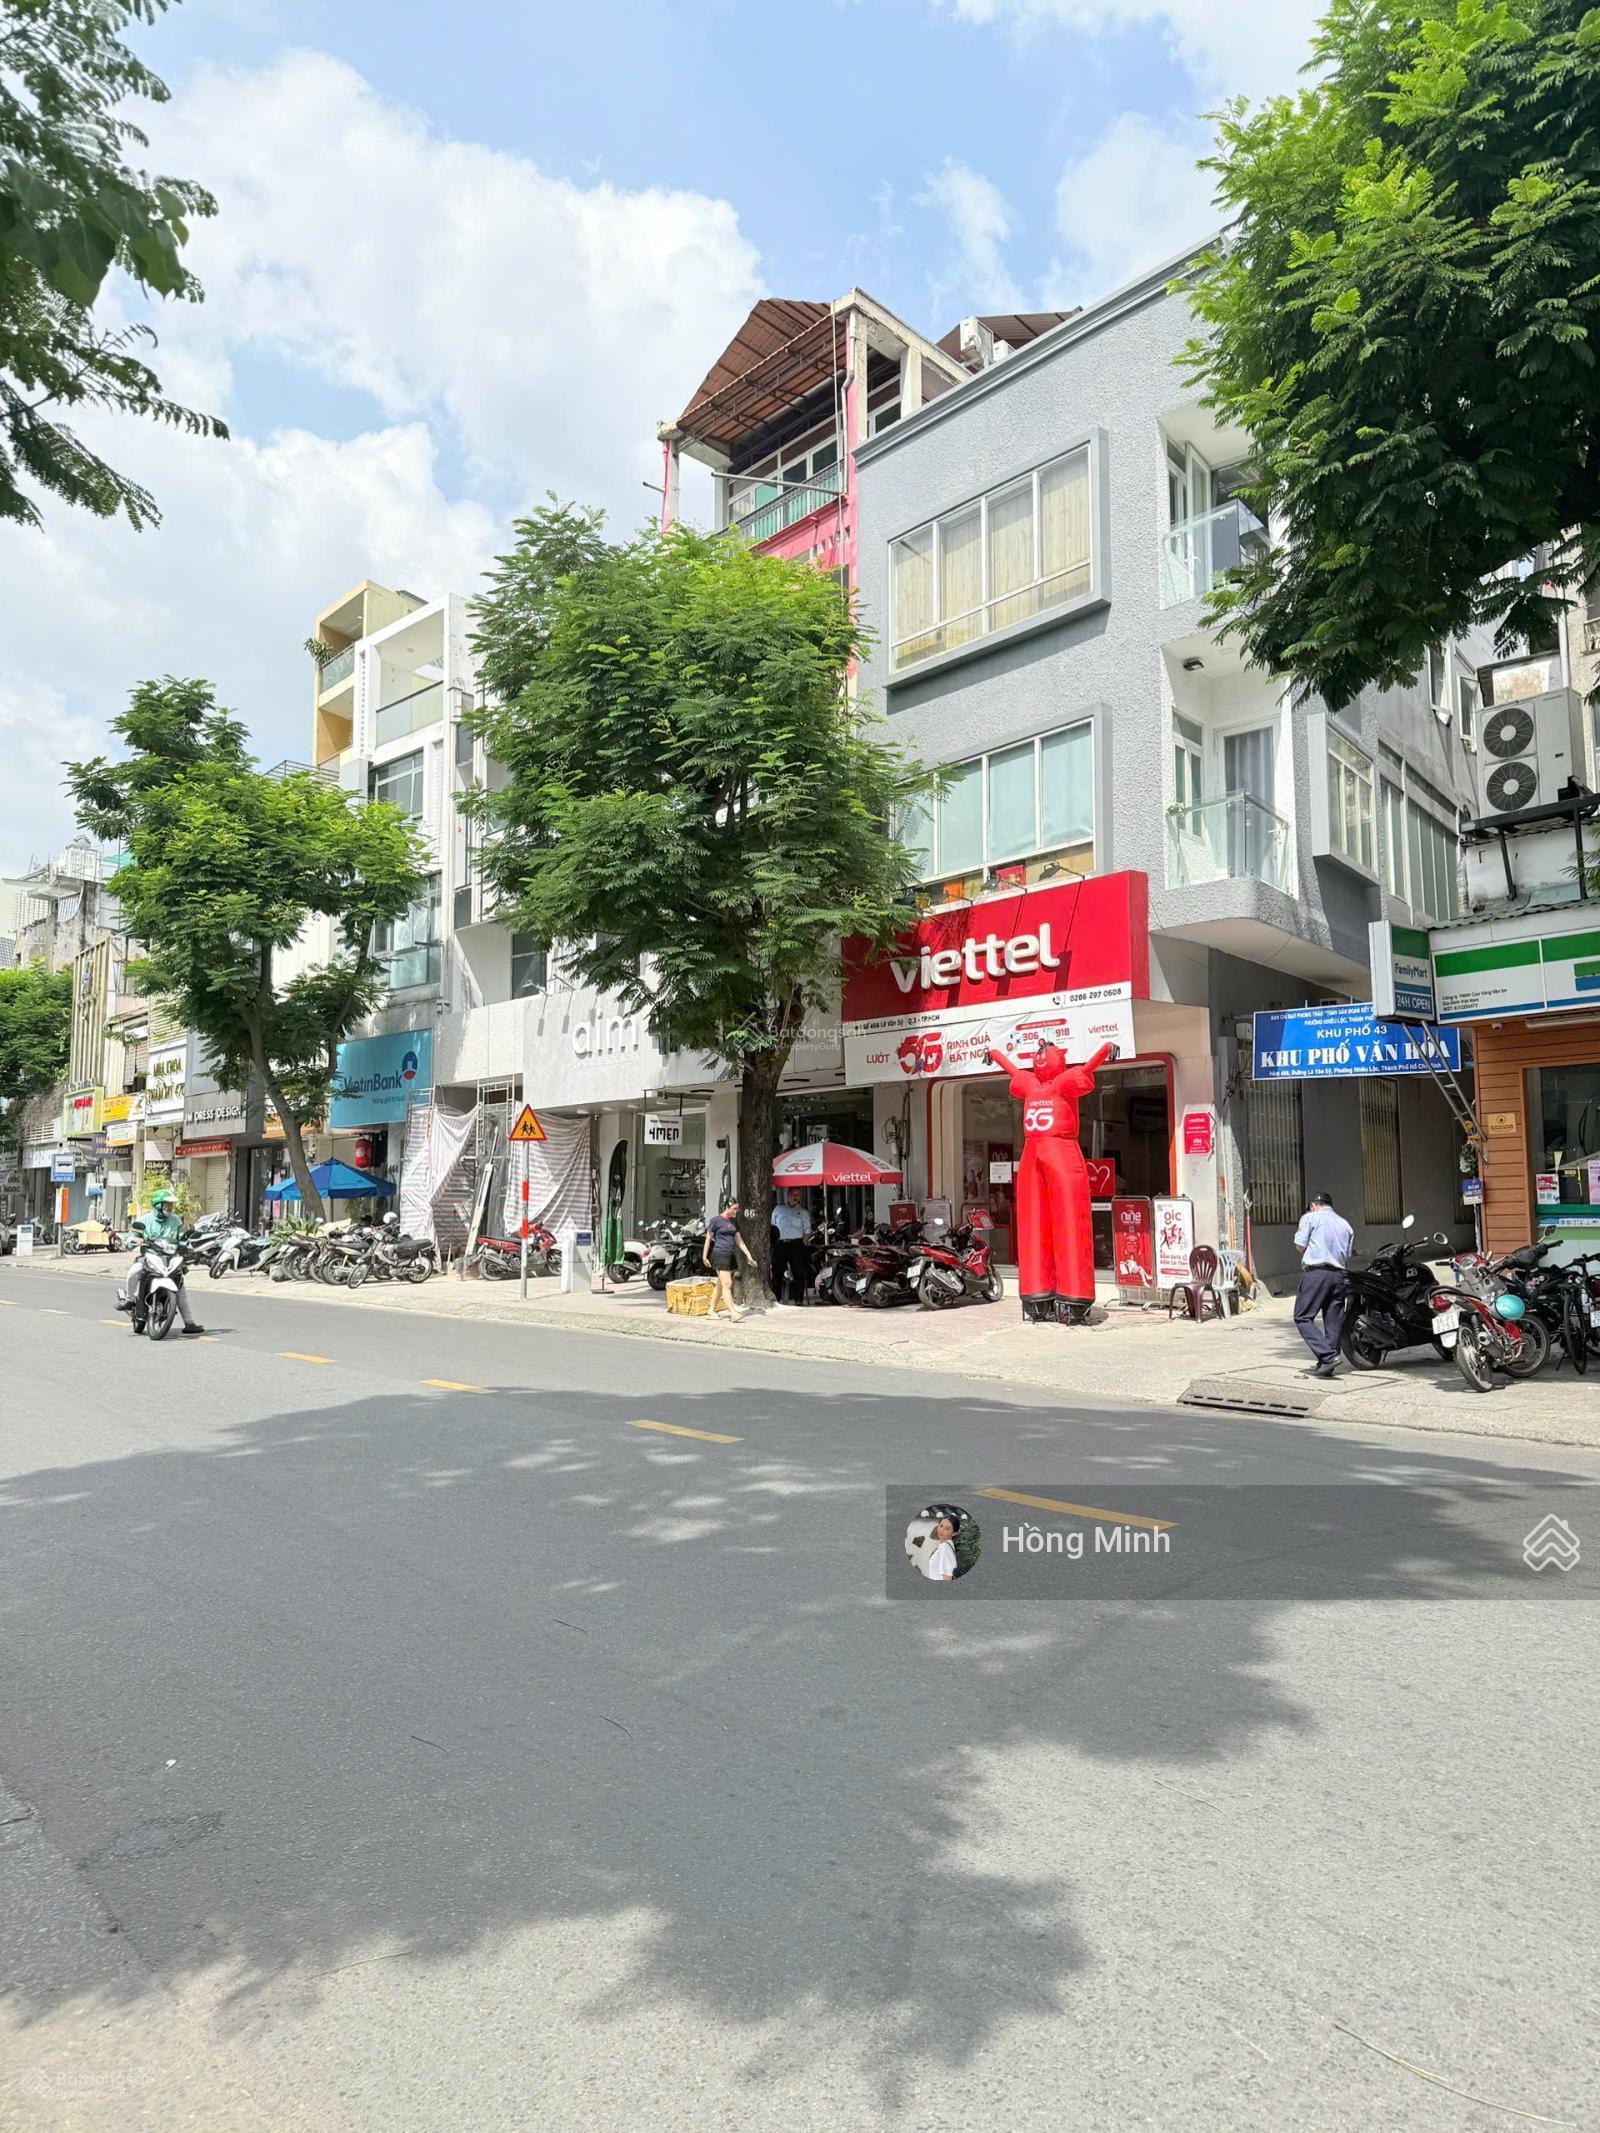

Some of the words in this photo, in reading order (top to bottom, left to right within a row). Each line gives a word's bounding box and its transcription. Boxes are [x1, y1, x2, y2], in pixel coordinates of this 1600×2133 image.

[890, 923, 1060, 993] viettel
[1395, 963, 1428, 979] FamilyMart
[1396, 995, 1410, 1007] 24H
[1412, 998, 1431, 1011] OPEN
[572, 1008, 639, 1054] aim
[1055, 1028, 1070, 1037] 918
[1088, 1023, 1119, 1034] viettel
[1317, 1028, 1341, 1039] KHU
[1345, 1023, 1371, 1037] PHỐ
[1373, 1025, 1387, 1034] 43
[1022, 1032, 1039, 1041] 306
[1261, 1050, 1302, 1068] KHU
[1308, 1039, 1351, 1065] PHỐ
[1355, 1040, 1398, 1063] VĂN
[194, 1108, 214, 1120] DRESS
[1024, 1108, 1054, 1132] 5G
[649, 1127, 679, 1140] 4MEN
[785, 1162, 813, 1172] 5G
[832, 1172, 872, 1183] viettel
